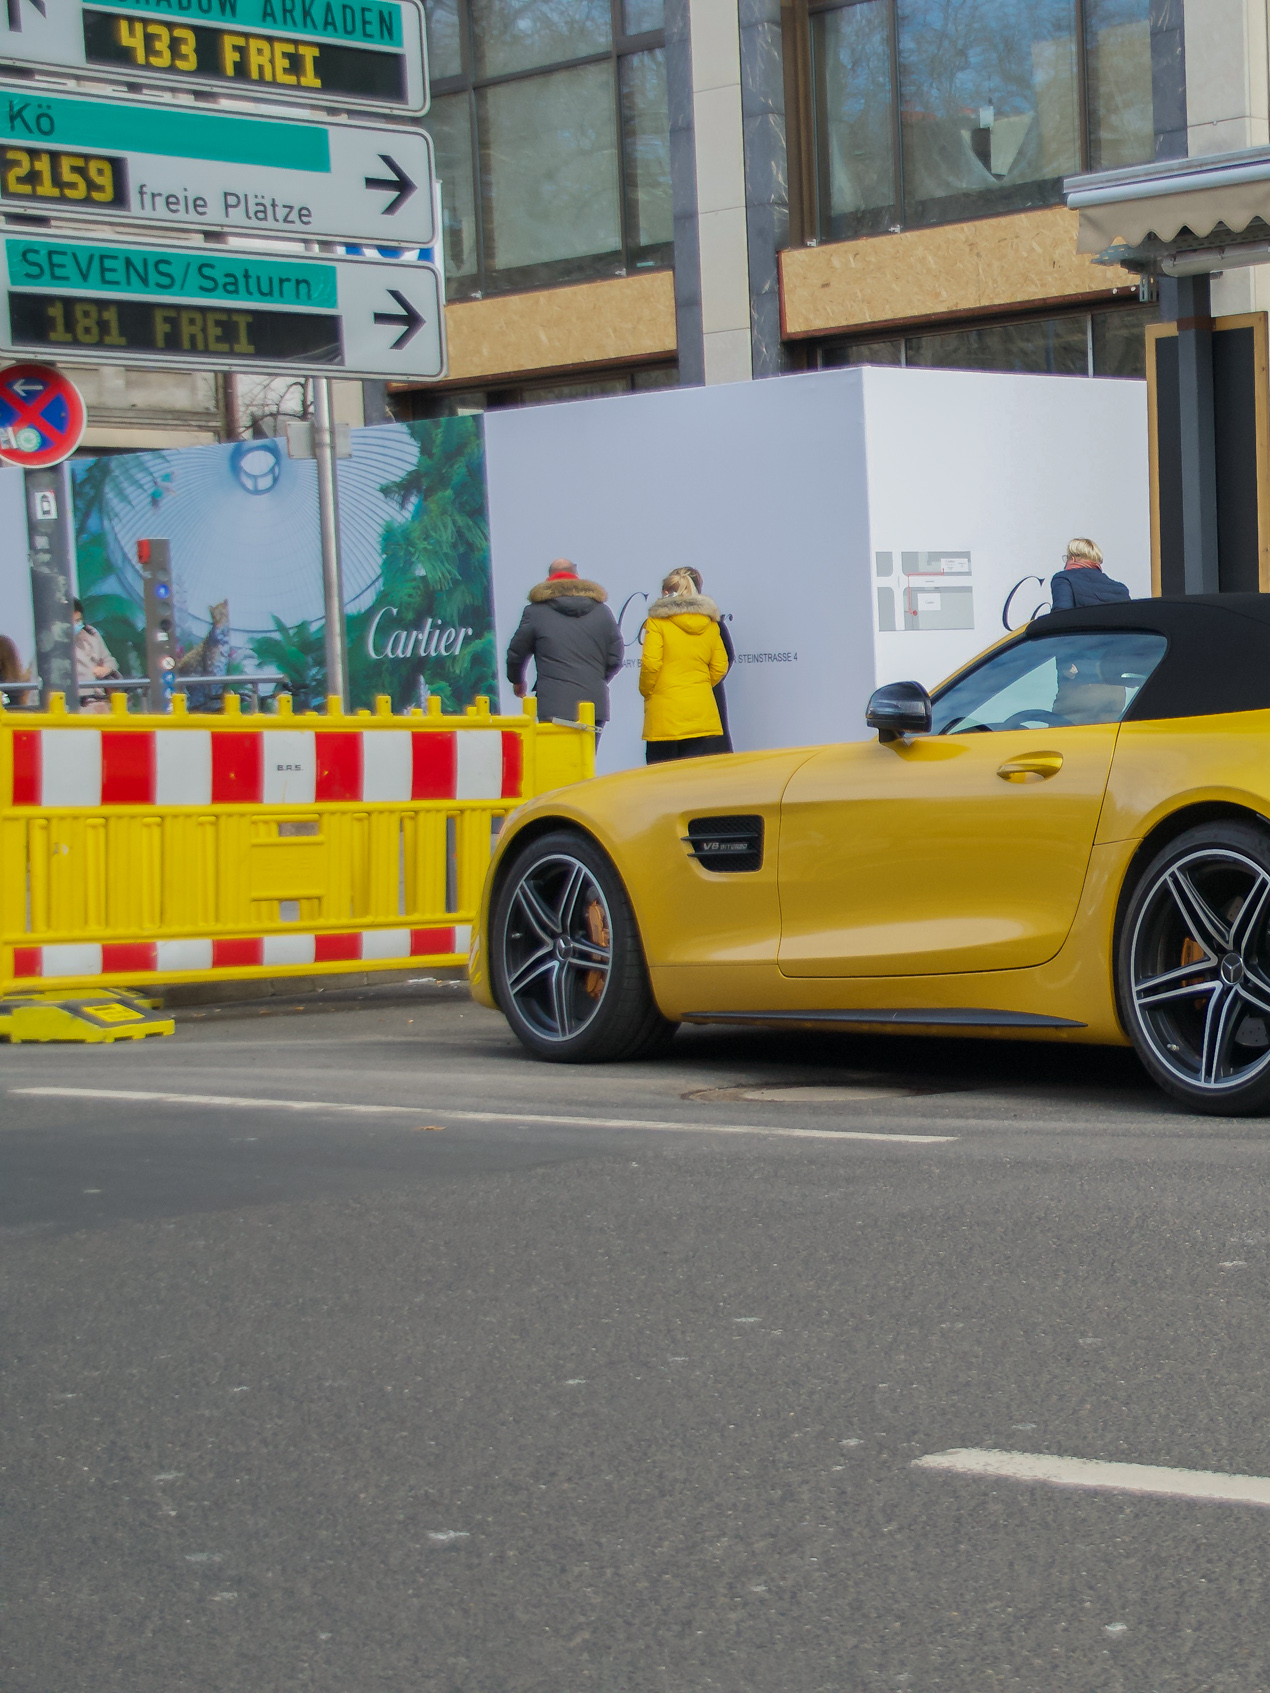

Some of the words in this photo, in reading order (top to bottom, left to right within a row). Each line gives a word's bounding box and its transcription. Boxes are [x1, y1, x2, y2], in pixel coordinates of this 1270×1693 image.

[262, 0, 394, 41] ARKADEN
[119, 19, 198, 72] 433
[222, 35, 322, 88] FREI
[9, 99, 55, 136] Kö
[6, 150, 114, 203] 2159
[138, 184, 209, 217] freie
[223, 191, 313, 226] Plätze
[21, 248, 312, 300] SEVENS/Saturn
[47, 301, 127, 347] 181
[154, 308, 256, 355] FREI
[368, 606, 473, 659] Cartier
[738, 652, 793, 664] STEINSTRASSE
[793, 652, 798, 662] 4
